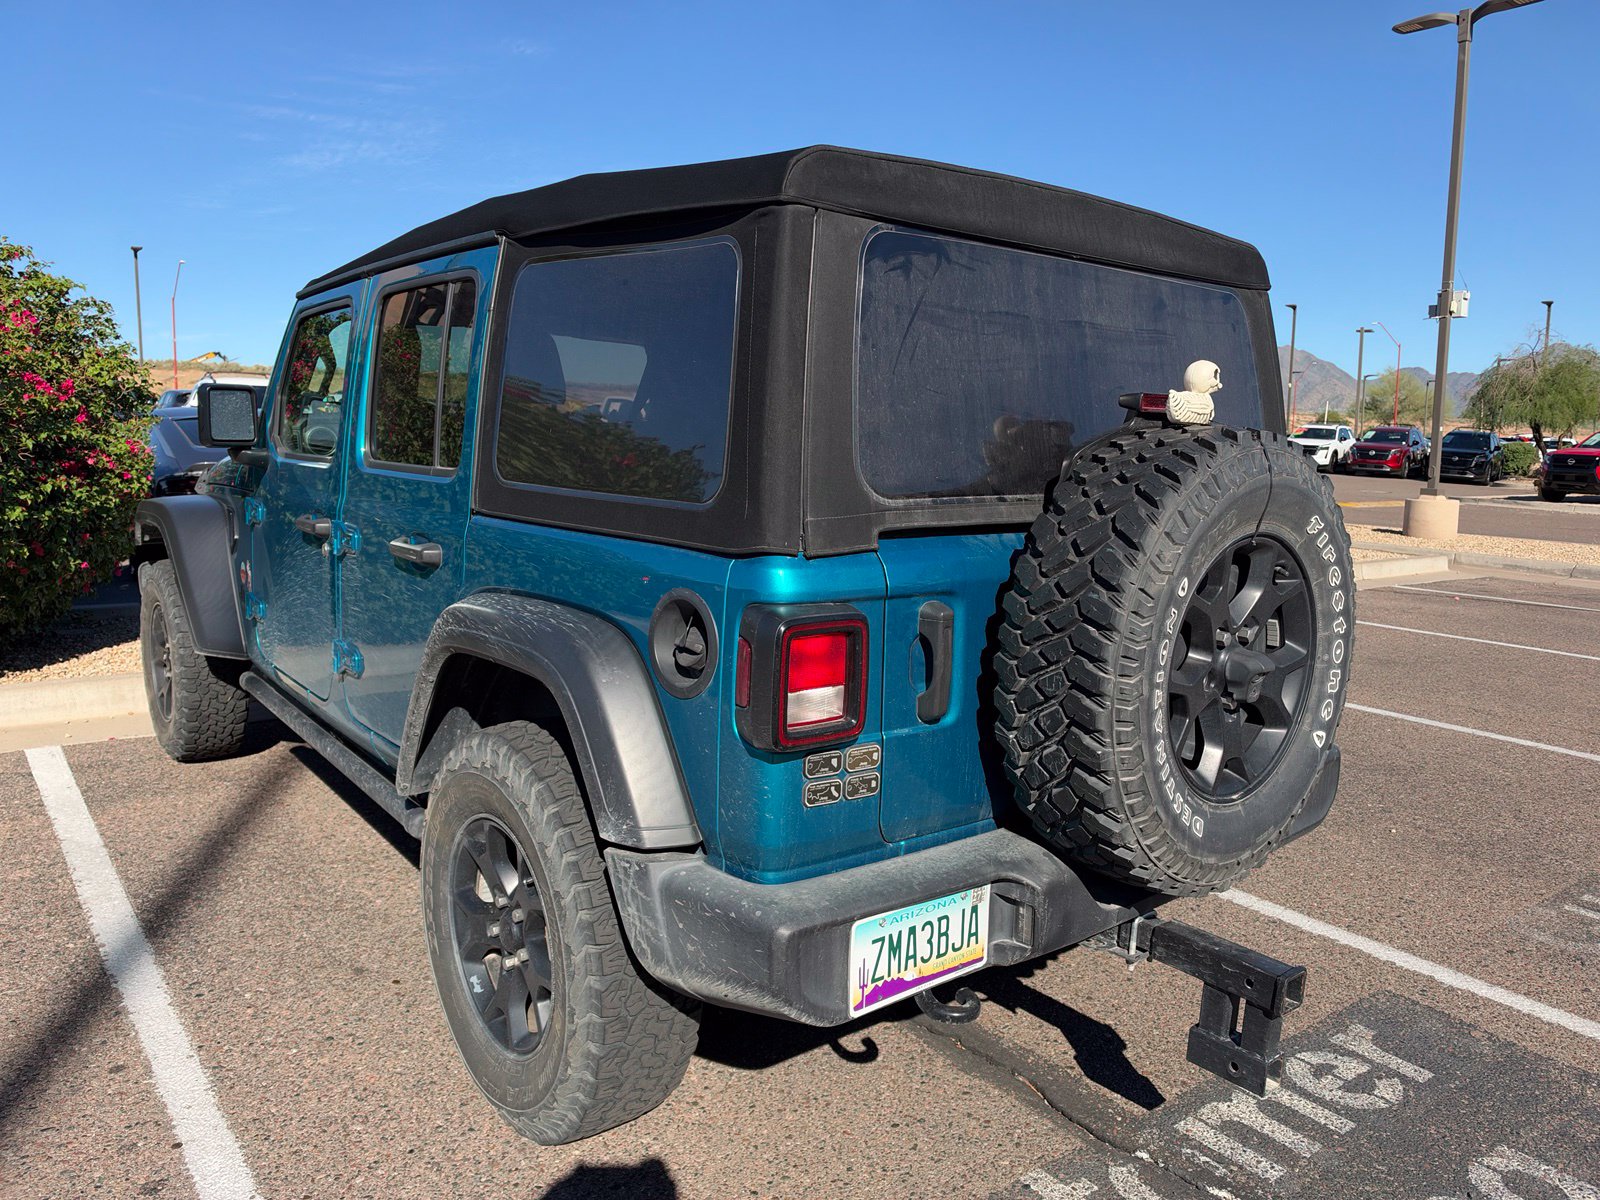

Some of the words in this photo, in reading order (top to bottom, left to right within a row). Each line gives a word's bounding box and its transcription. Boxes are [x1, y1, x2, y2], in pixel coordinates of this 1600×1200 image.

[1306, 515, 1346, 722] Firestone
[1154, 607, 1204, 838] DESTINATION
[870, 904, 979, 985] ZMA3BJA
[889, 897, 958, 926] ARIZONA
